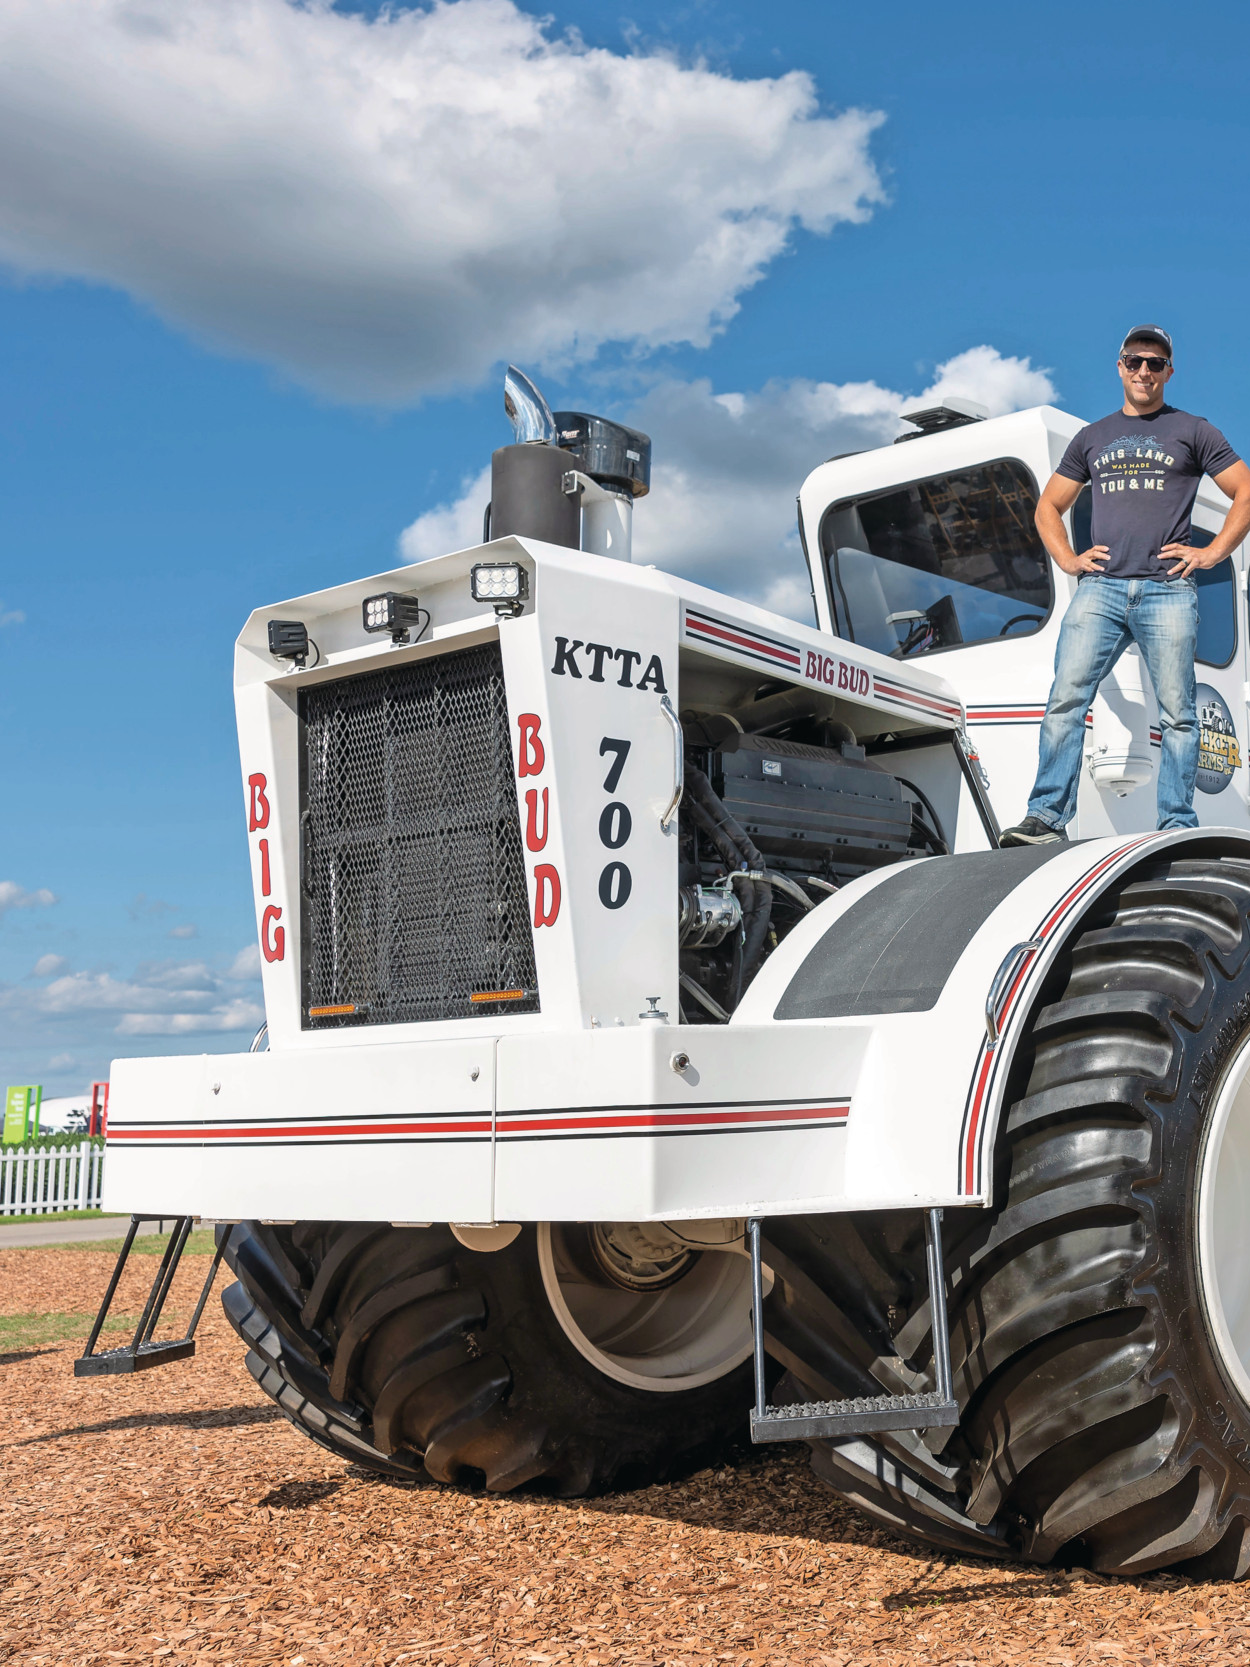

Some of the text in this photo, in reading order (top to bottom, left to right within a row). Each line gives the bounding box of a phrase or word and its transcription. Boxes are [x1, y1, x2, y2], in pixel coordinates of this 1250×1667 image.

[1094, 447, 1175, 470] THIS LAND
[1100, 478, 1165, 495] YOU & ME
[551, 636, 668, 695] KTTA
[805, 650, 870, 697] BIG BUD
[1200, 728, 1242, 768] LKER
[517, 713, 561, 928] BUD
[598, 736, 632, 910] 700
[248, 773, 285, 963] BIG
